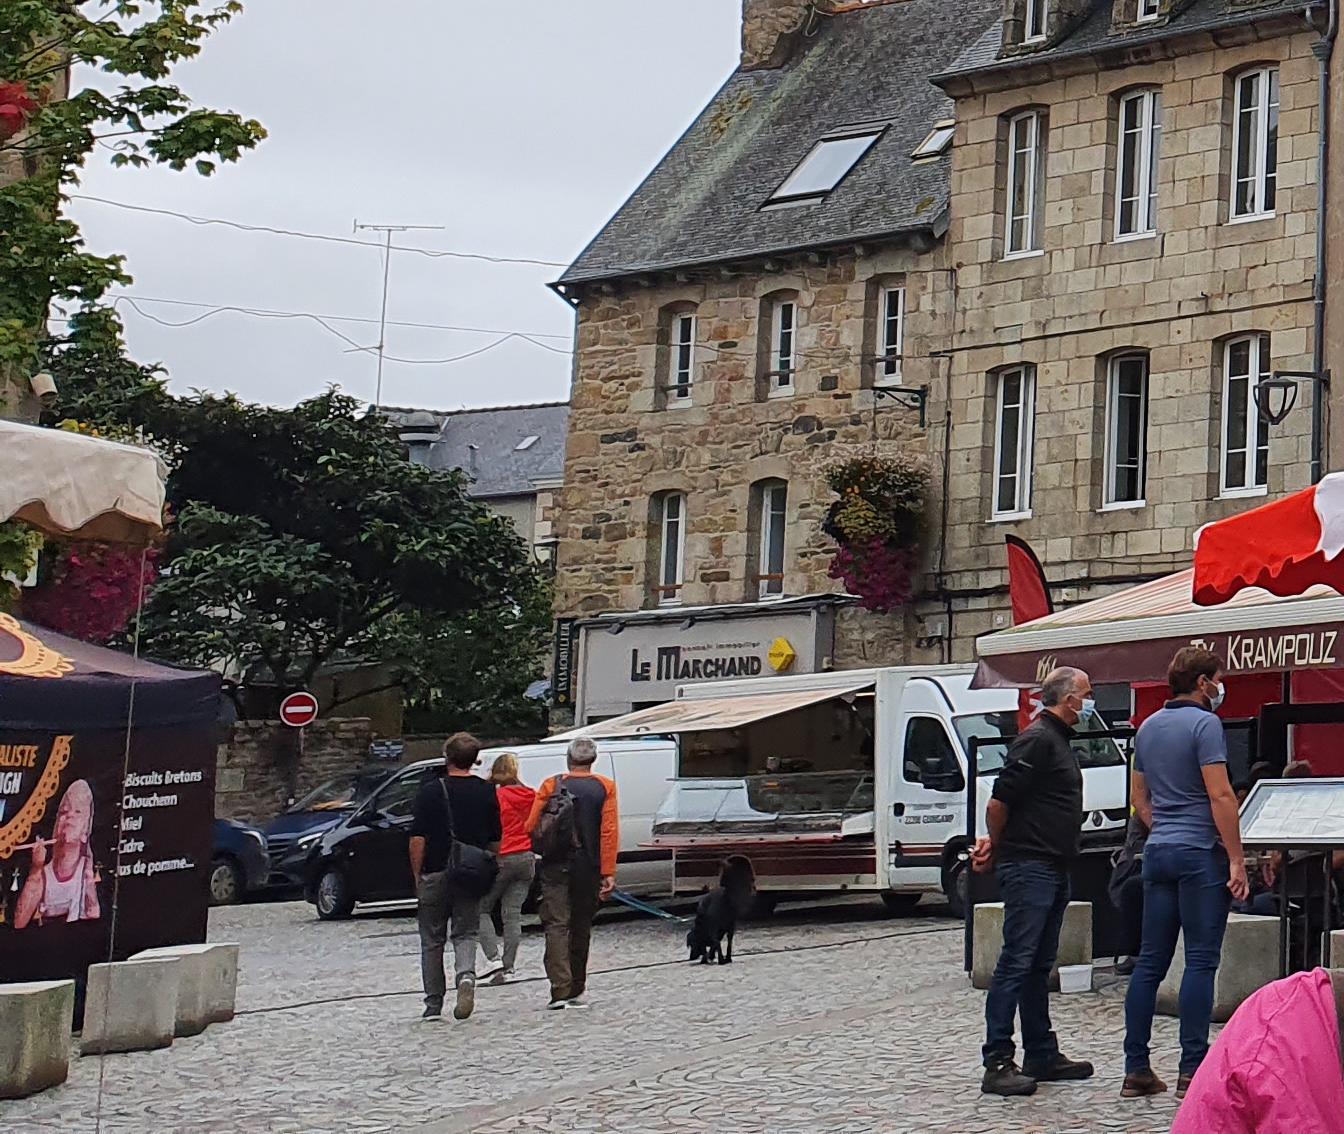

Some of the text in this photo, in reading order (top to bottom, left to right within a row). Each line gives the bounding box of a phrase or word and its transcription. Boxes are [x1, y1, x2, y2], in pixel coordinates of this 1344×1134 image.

[656, 645, 762, 681] MARCHAND
[1226, 631, 1338, 670] KRAMPOUZ
[119, 866, 132, 877] us
